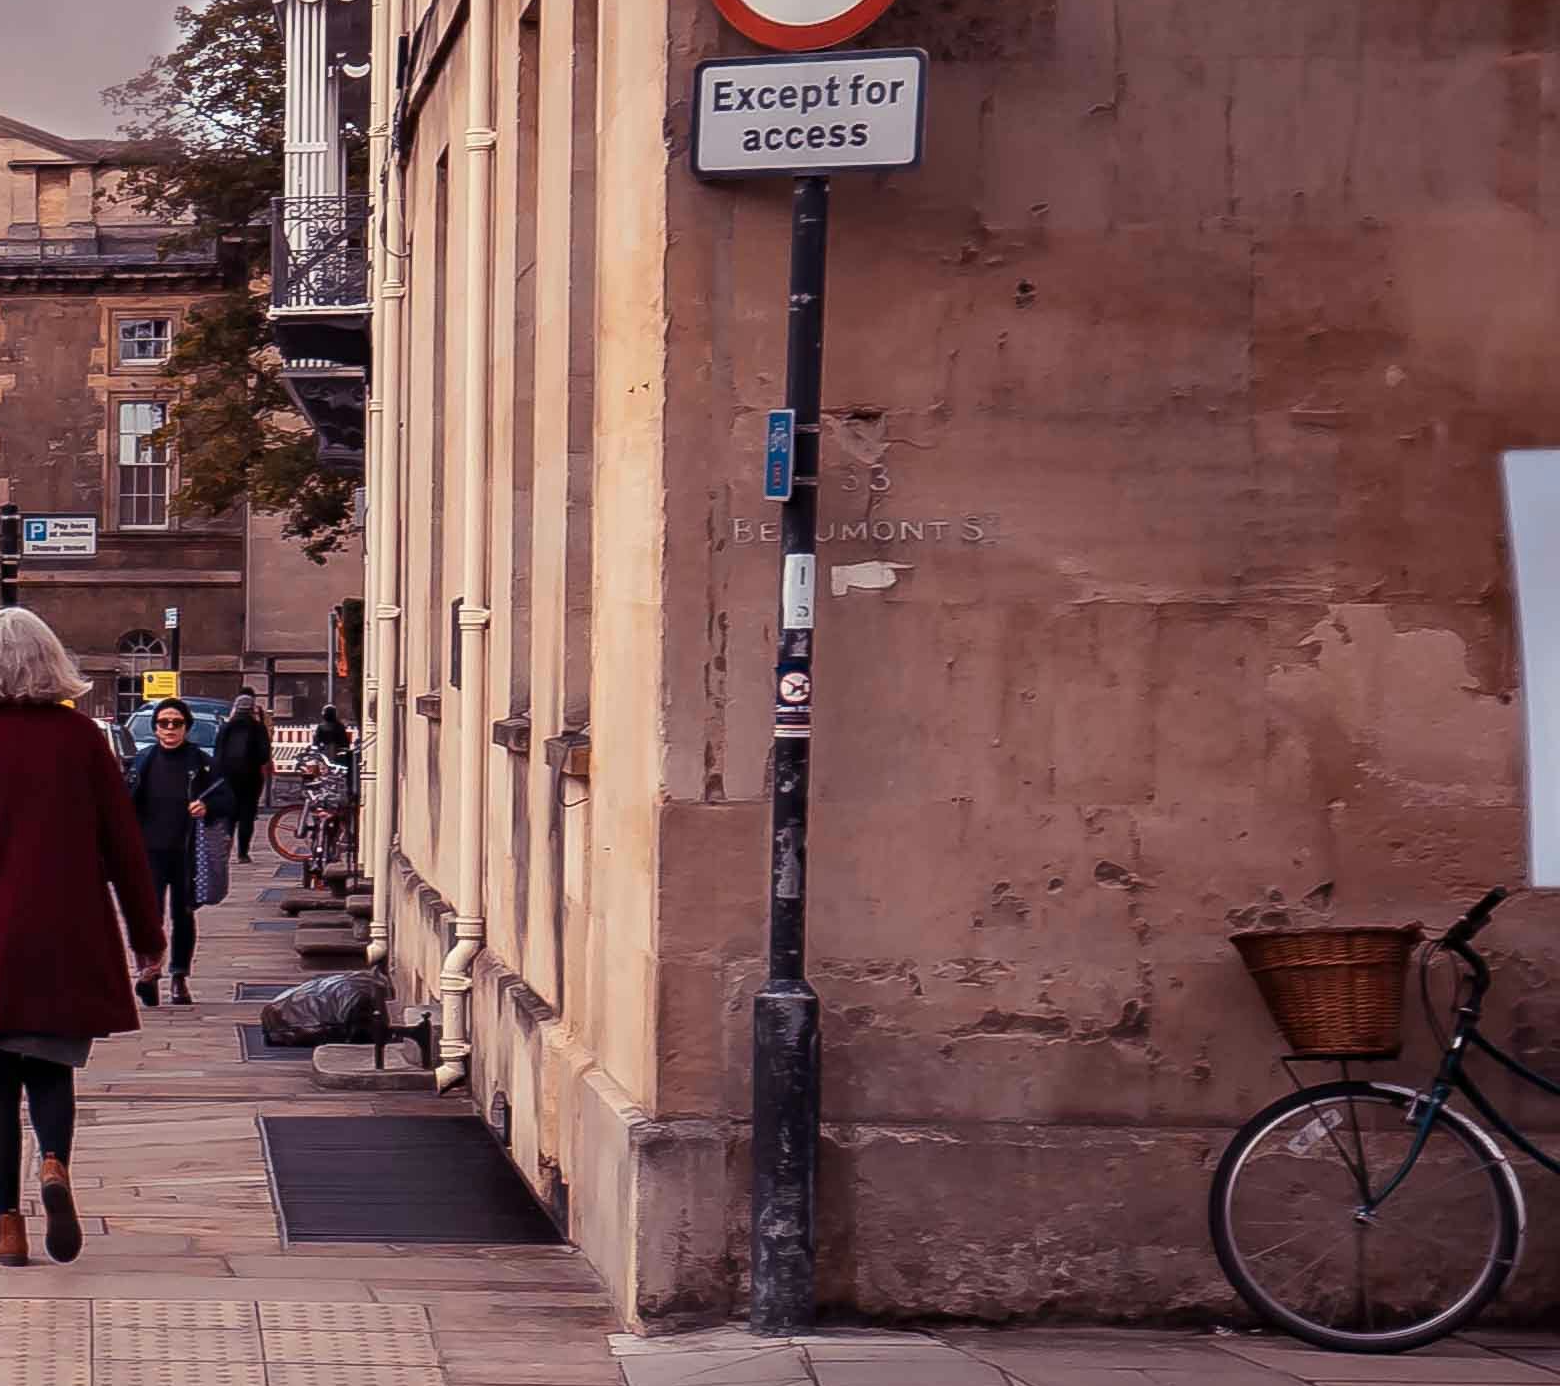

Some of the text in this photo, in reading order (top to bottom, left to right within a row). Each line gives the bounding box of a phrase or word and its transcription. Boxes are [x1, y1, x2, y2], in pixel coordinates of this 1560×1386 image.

[713, 74, 904, 114] Except for
[743, 122, 868, 151] access
[729, 518, 951, 543] BEUMONT
